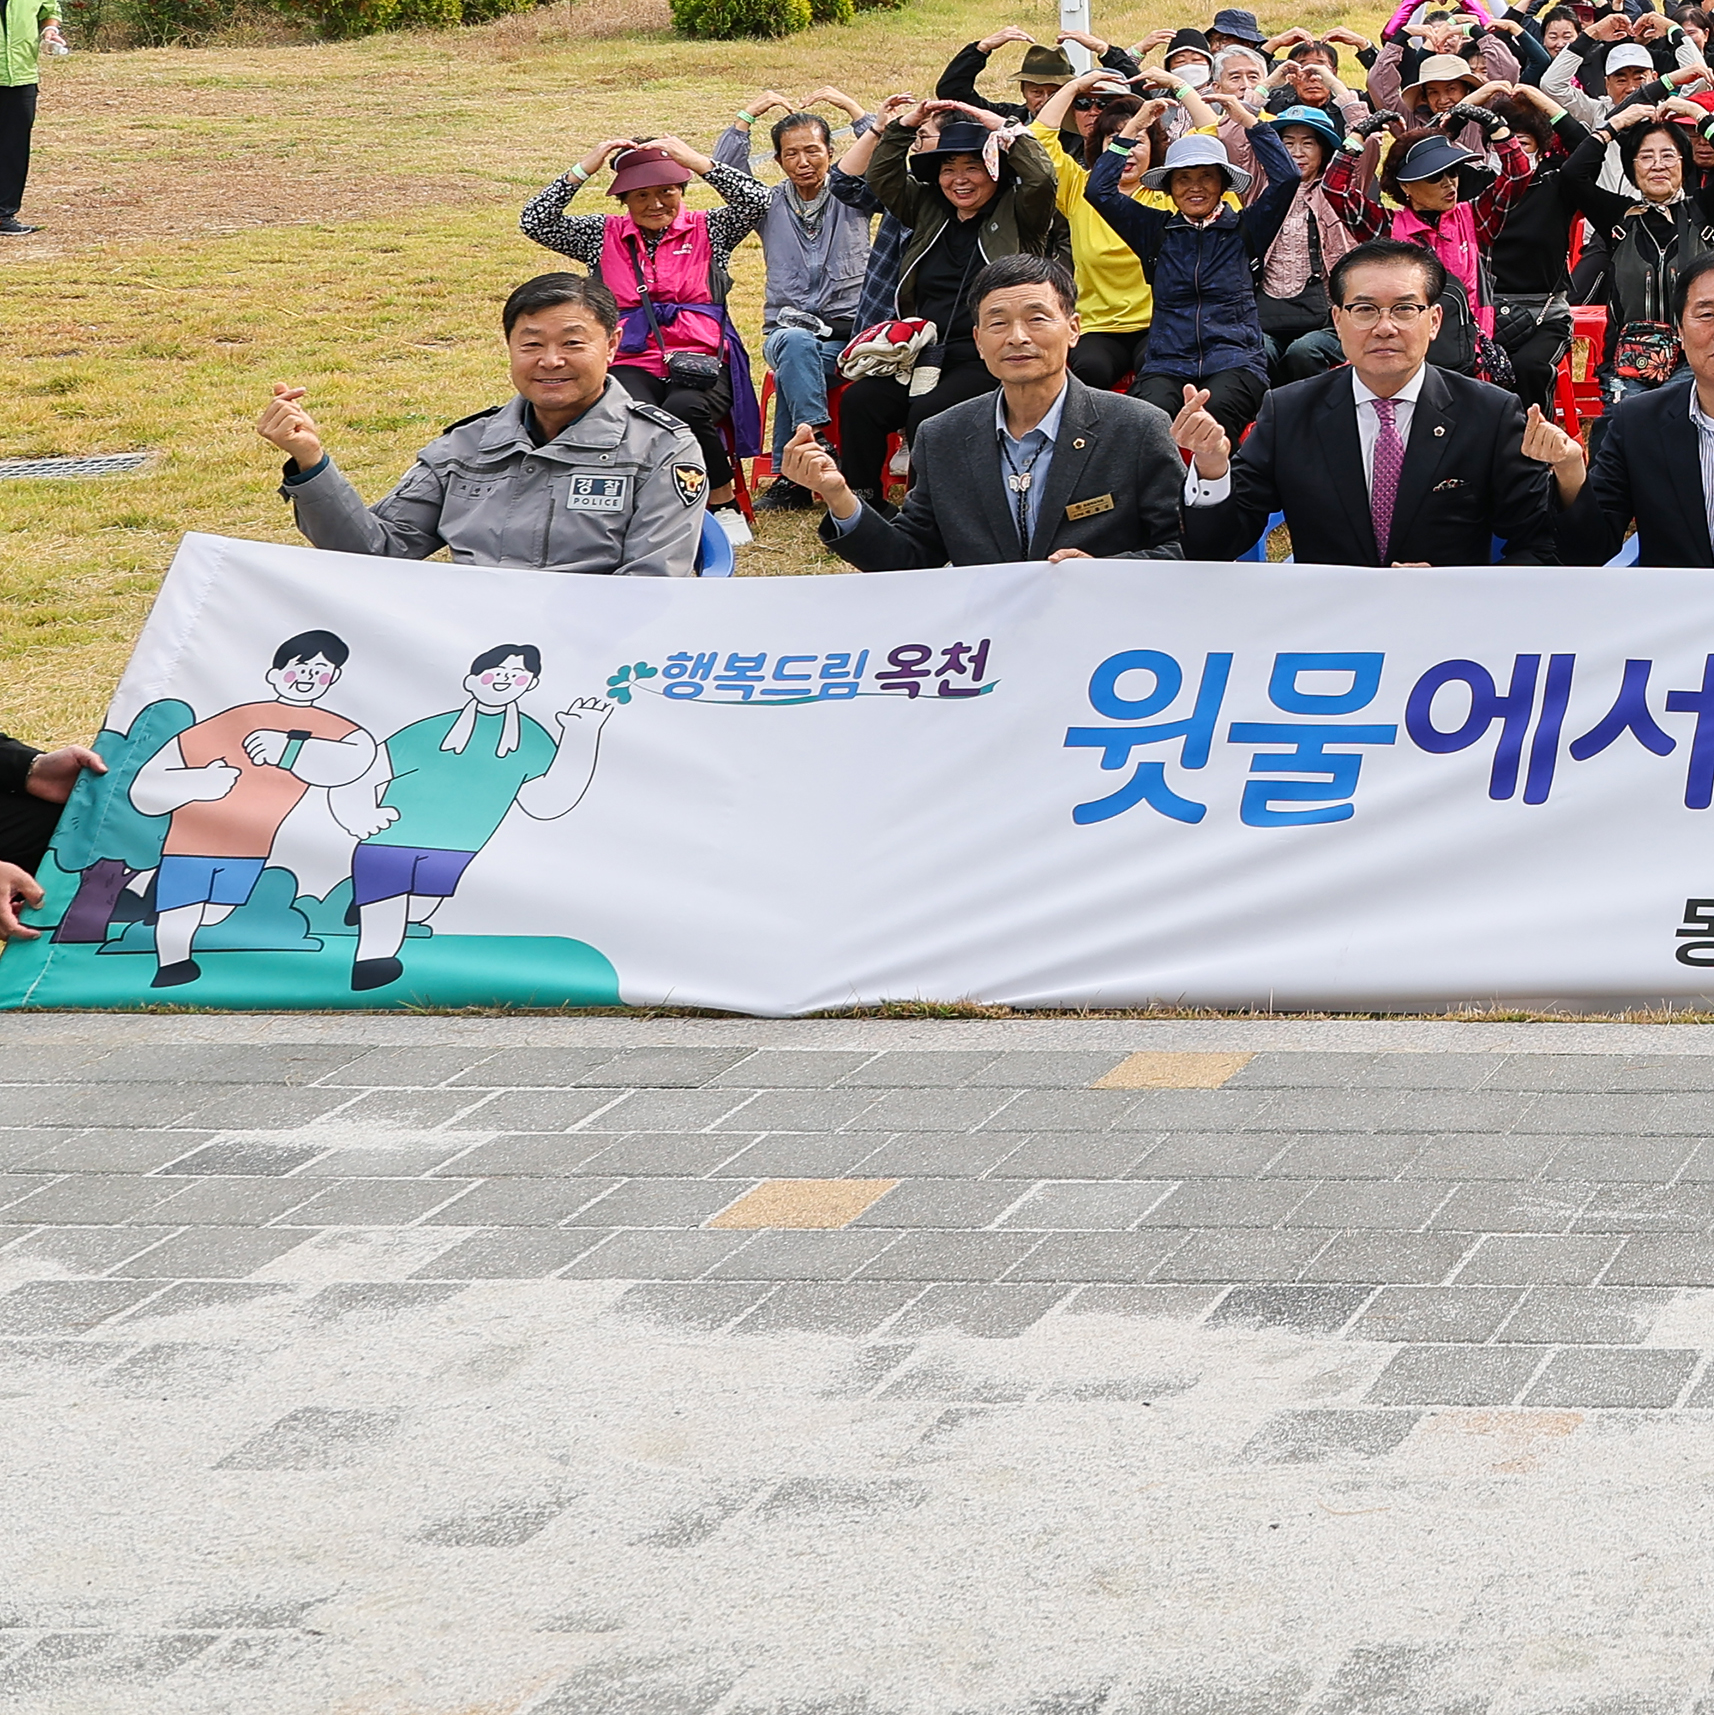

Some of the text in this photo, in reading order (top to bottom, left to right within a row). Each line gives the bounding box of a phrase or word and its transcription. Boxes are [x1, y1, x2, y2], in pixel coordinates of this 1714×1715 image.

[576, 478, 621, 496] 경찰
[573, 496, 619, 507] POLICE
[661, 638, 991, 701] 행복드림 옥천
